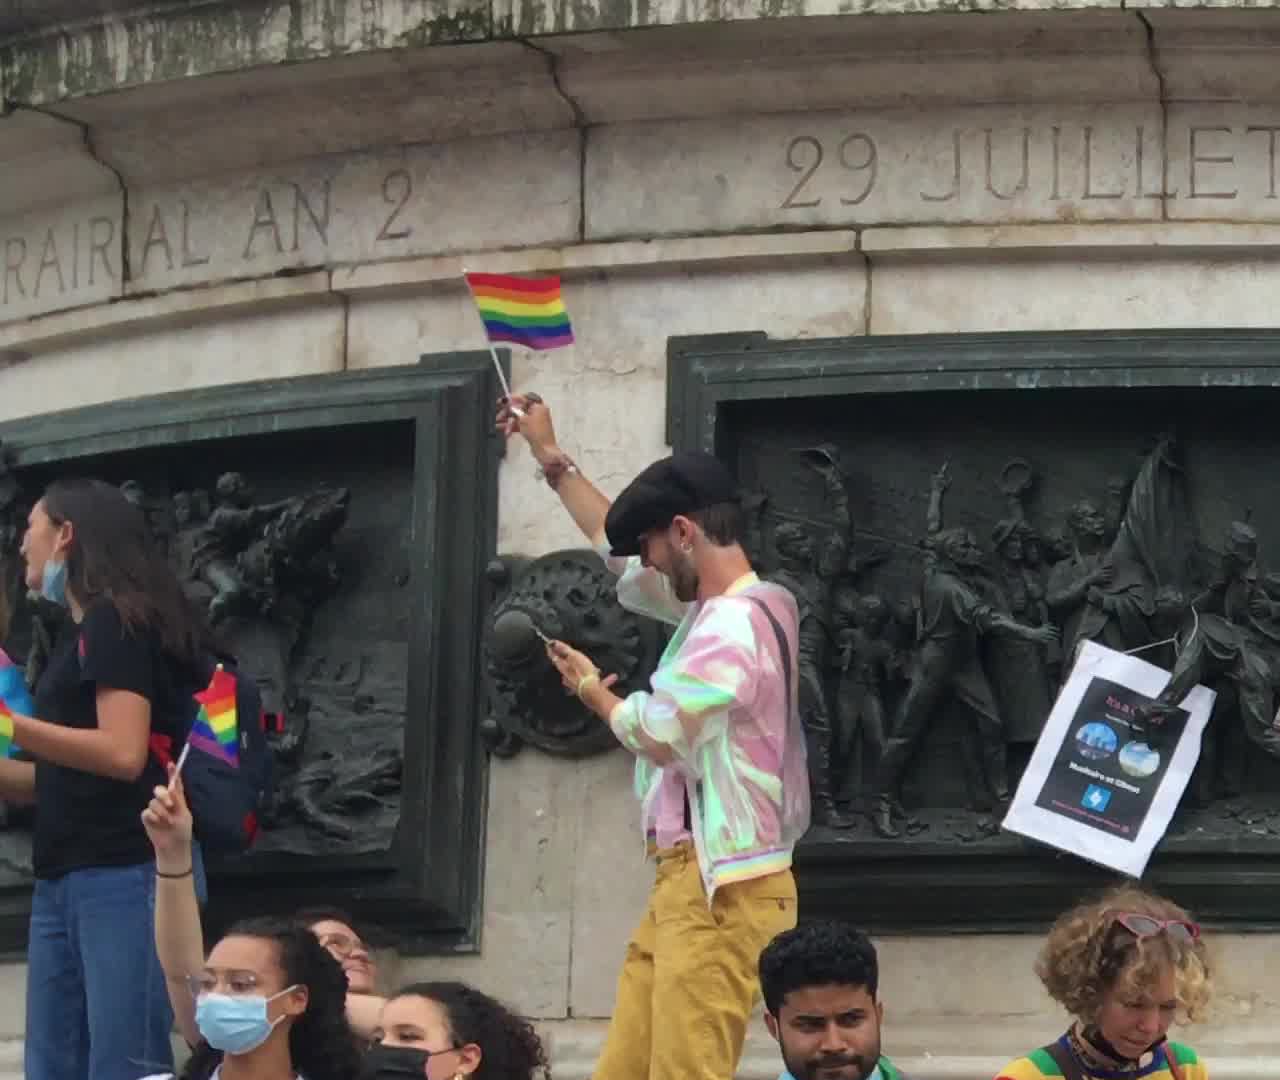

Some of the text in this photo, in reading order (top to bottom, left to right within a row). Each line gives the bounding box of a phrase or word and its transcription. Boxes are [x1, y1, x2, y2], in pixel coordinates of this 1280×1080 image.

[779, 132, 878, 209] 29
[242, 178, 331, 261] AN
[375, 169, 413, 242] 2
